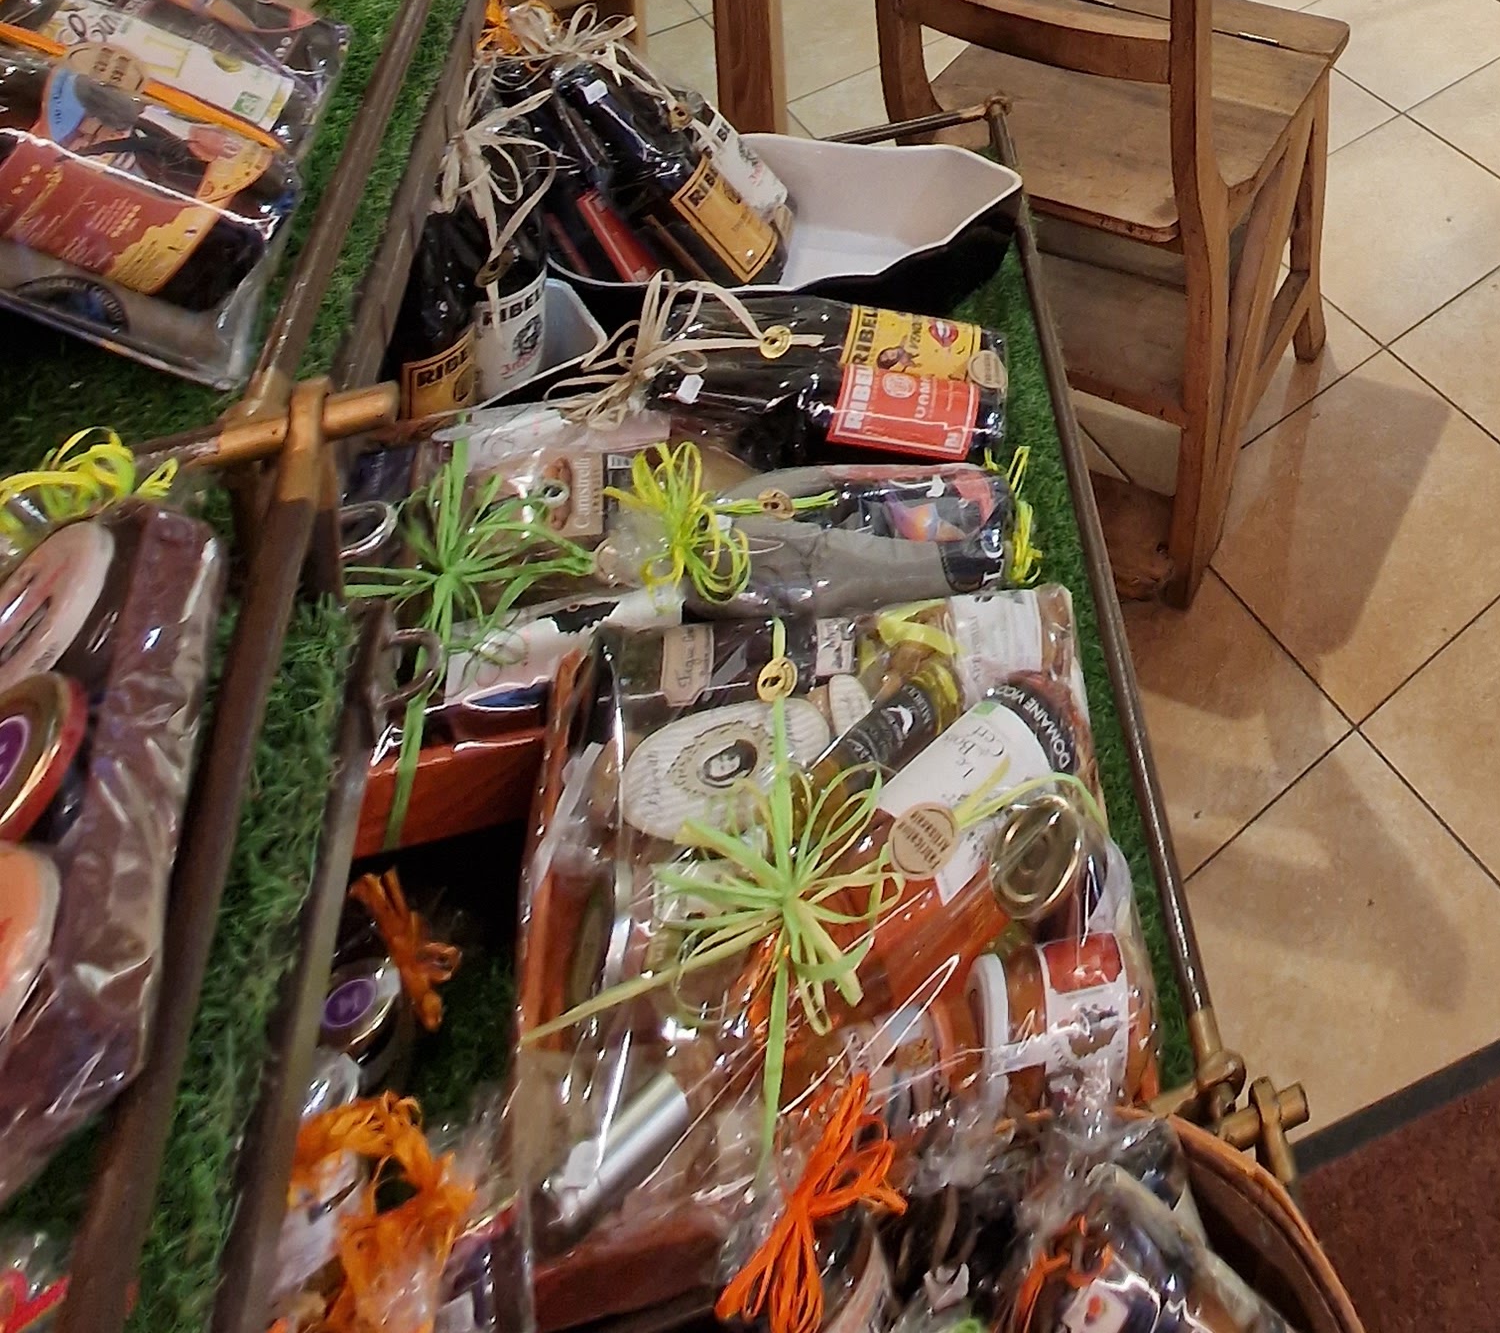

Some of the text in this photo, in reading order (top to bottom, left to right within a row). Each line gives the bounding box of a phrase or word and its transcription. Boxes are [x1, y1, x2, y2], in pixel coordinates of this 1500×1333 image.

[1024, 696, 1070, 771] DOMAINE
[896, 819, 942, 870] Fabrication
[909, 807, 950, 852] Artisanale
